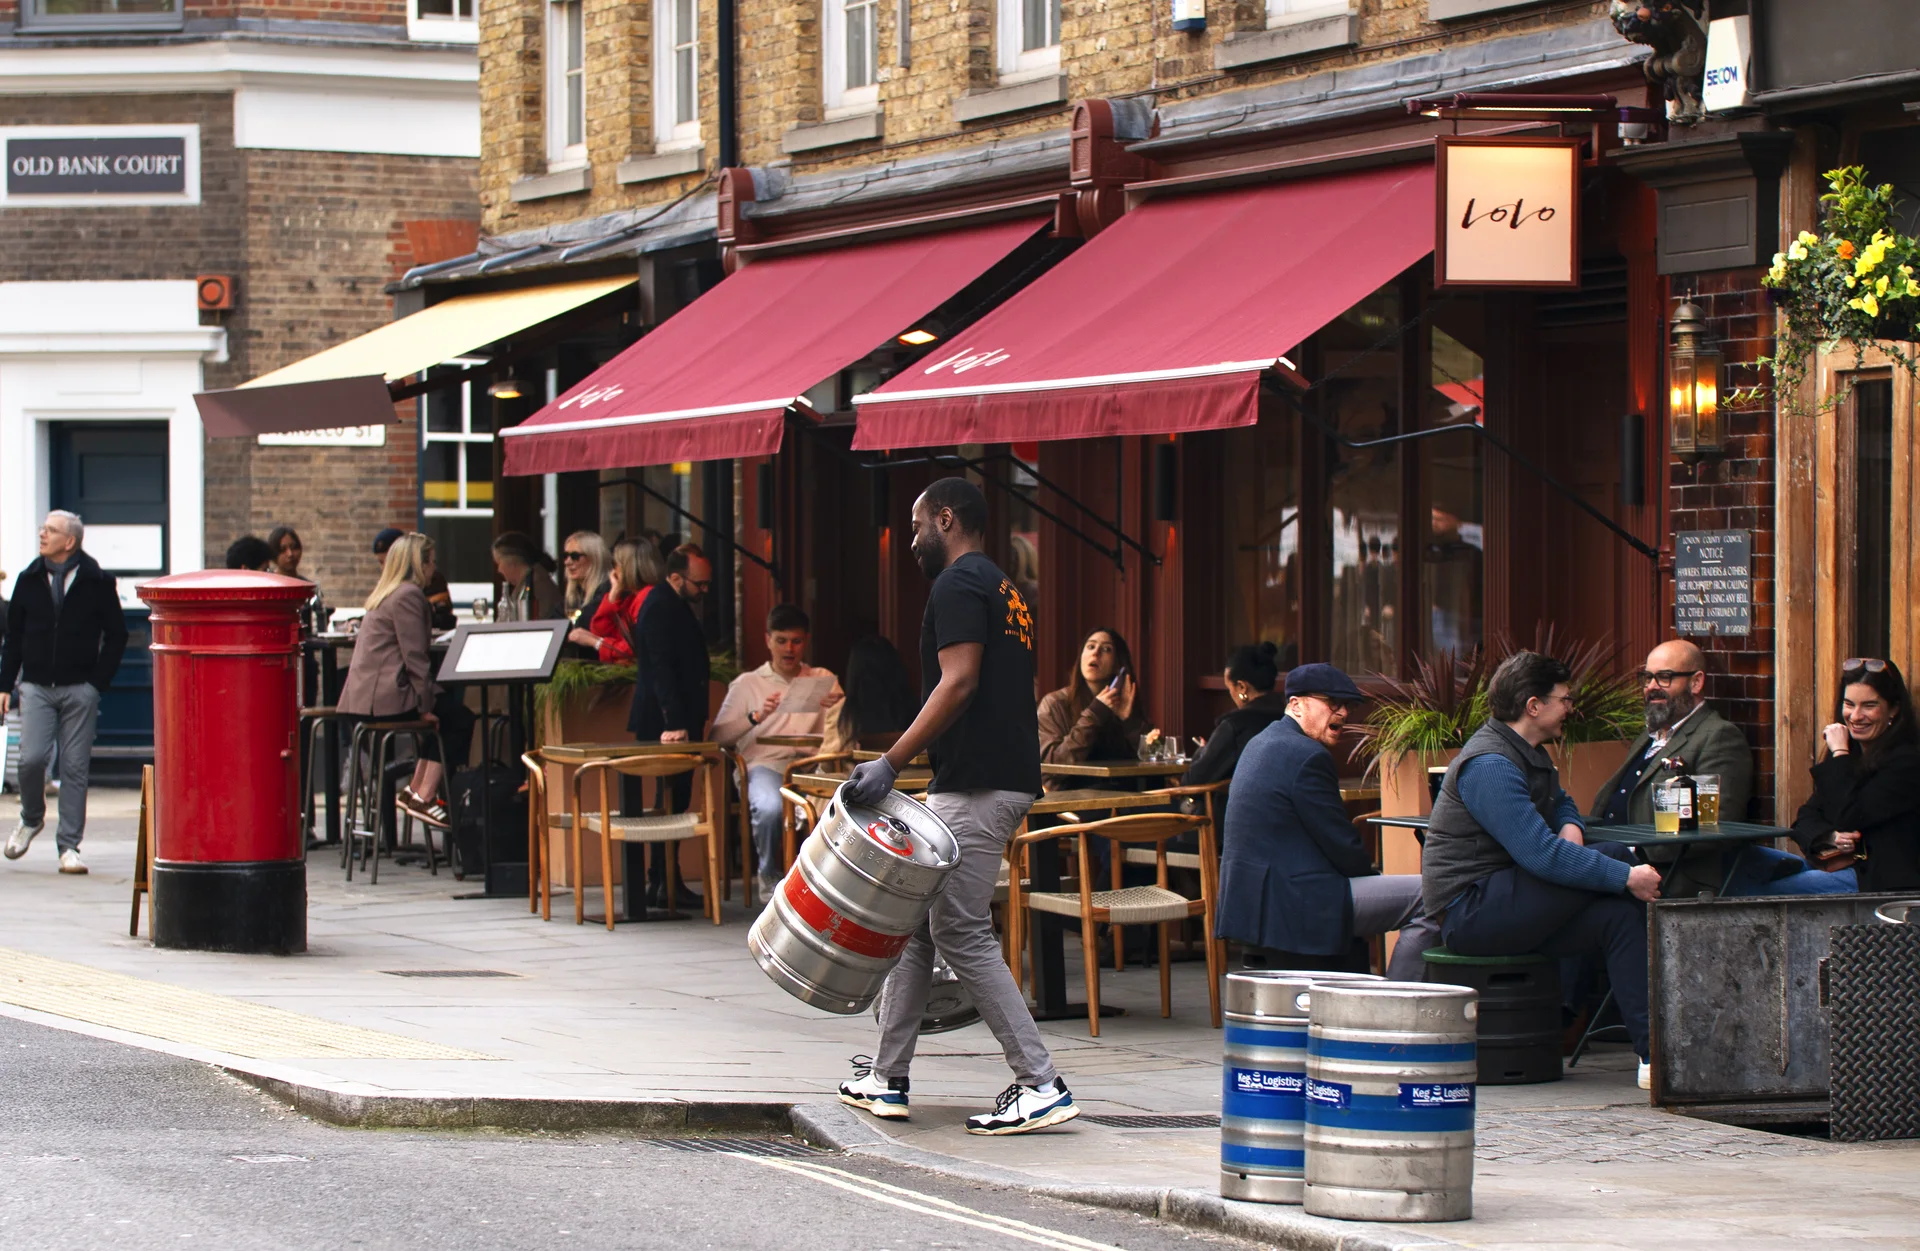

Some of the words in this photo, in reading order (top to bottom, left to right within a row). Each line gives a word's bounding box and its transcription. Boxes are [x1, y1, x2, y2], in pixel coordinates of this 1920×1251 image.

[1706, 66, 1738, 87] SECOM
[13, 156, 54, 176] OLD
[58, 155, 110, 176] BANK
[114, 154, 182, 175] COURT
[1682, 536, 1701, 545] LONDON
[1702, 535, 1721, 544] COUNTY
[1723, 534, 1743, 543] COUNCIL
[1699, 547, 1724, 559] NOTICE
[1678, 580, 1687, 590] ARE
[1713, 580, 1727, 590] FROM
[1727, 579, 1748, 590] CALLING
[1710, 593, 1725, 604] USING
[1725, 593, 1736, 603] ANY
[1678, 607, 1686, 617] OR
[1687, 607, 1705, 617] OTHER
[1707, 607, 1737, 617] INSTRUMENT
[1740, 606, 1748, 617] IN
[1678, 621, 1692, 631] THESE
[1237, 1072, 1251, 1086] Keg
[1263, 1074, 1302, 1088] Logistics
[1313, 1083, 1340, 1098] Logistics
[1412, 1087, 1431, 1099] Keg
